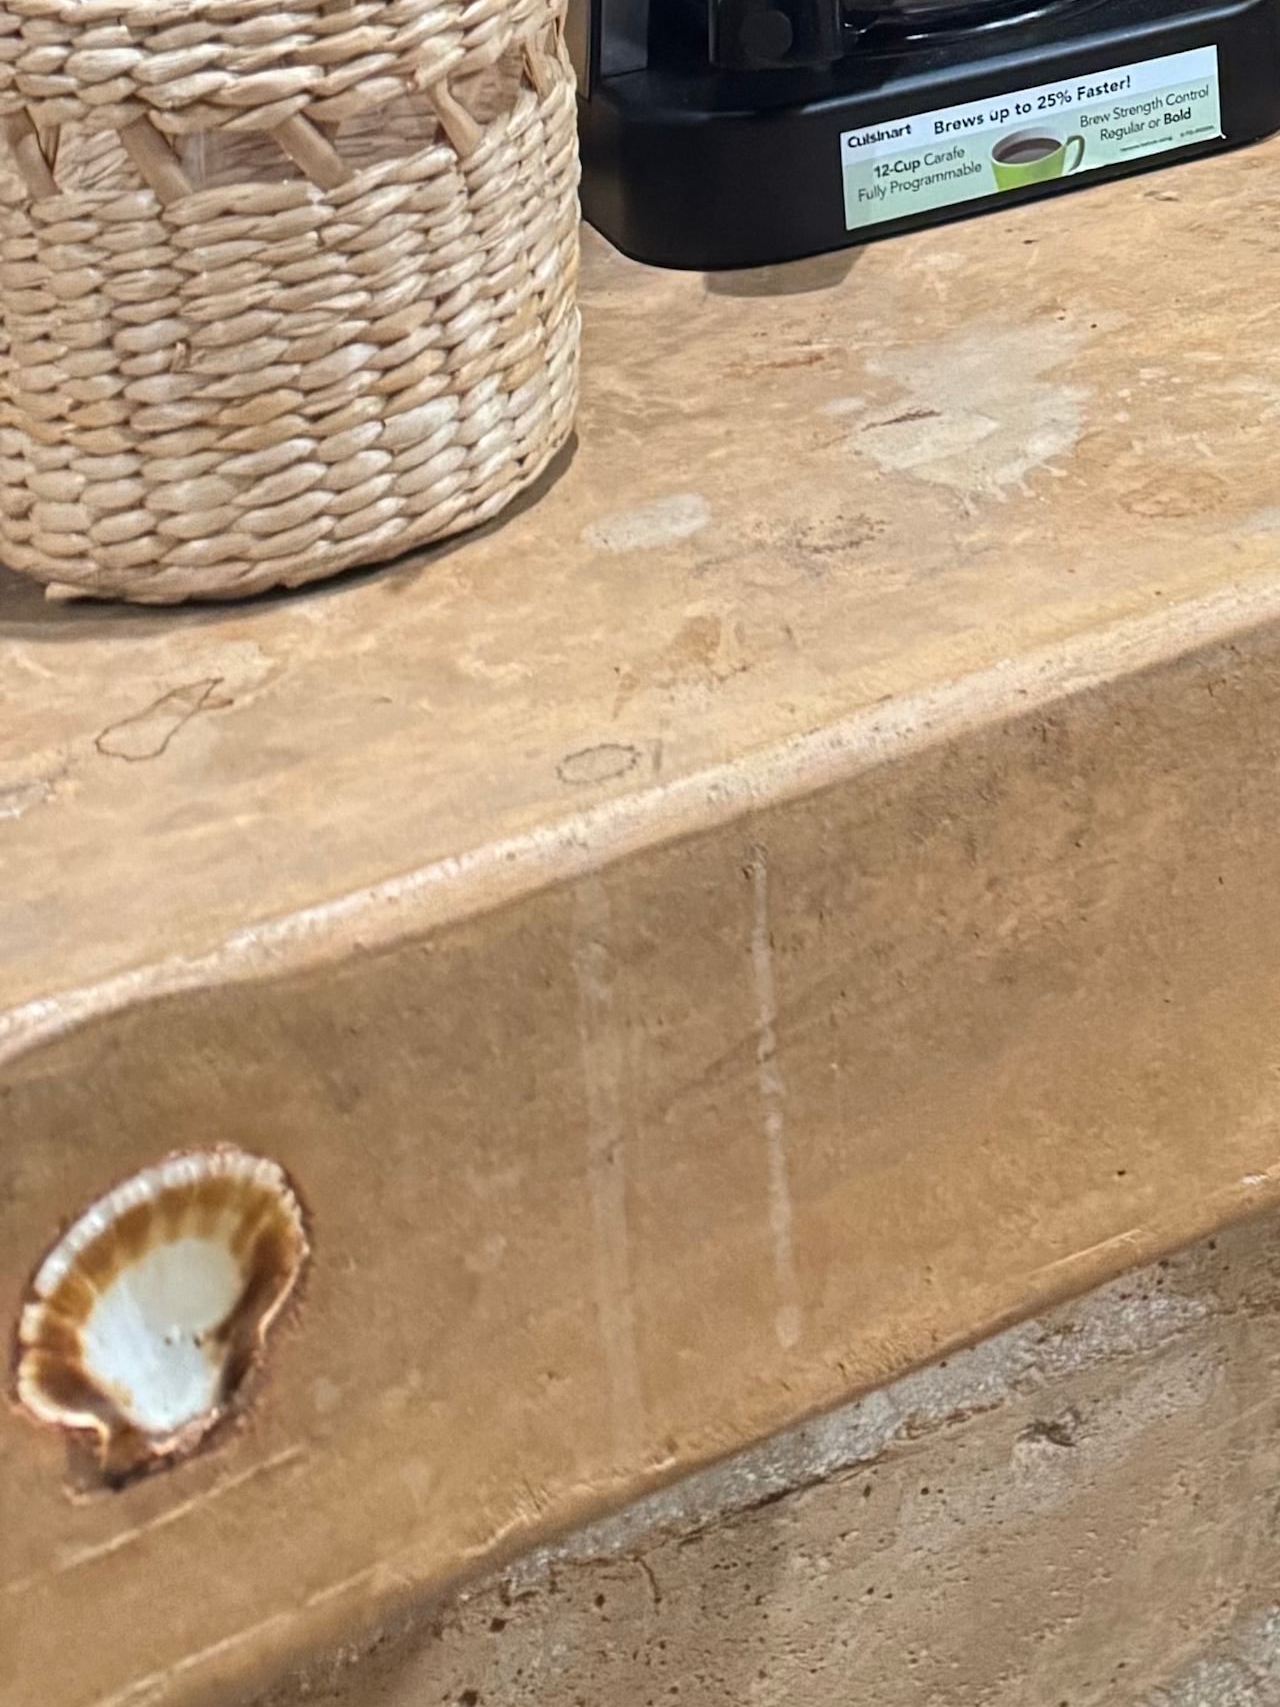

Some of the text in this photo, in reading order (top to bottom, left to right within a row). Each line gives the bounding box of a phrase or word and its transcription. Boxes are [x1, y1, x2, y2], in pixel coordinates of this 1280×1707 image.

[847, 75, 1131, 148] Cuisinart Brews up to 25% Faster!
[1080, 84, 1209, 128] Brew Strength Control
[1100, 108, 1192, 142] Regular or Bold
[858, 161, 983, 202] Fully Programmable
[874, 145, 965, 179] 12-Cup Carafe
